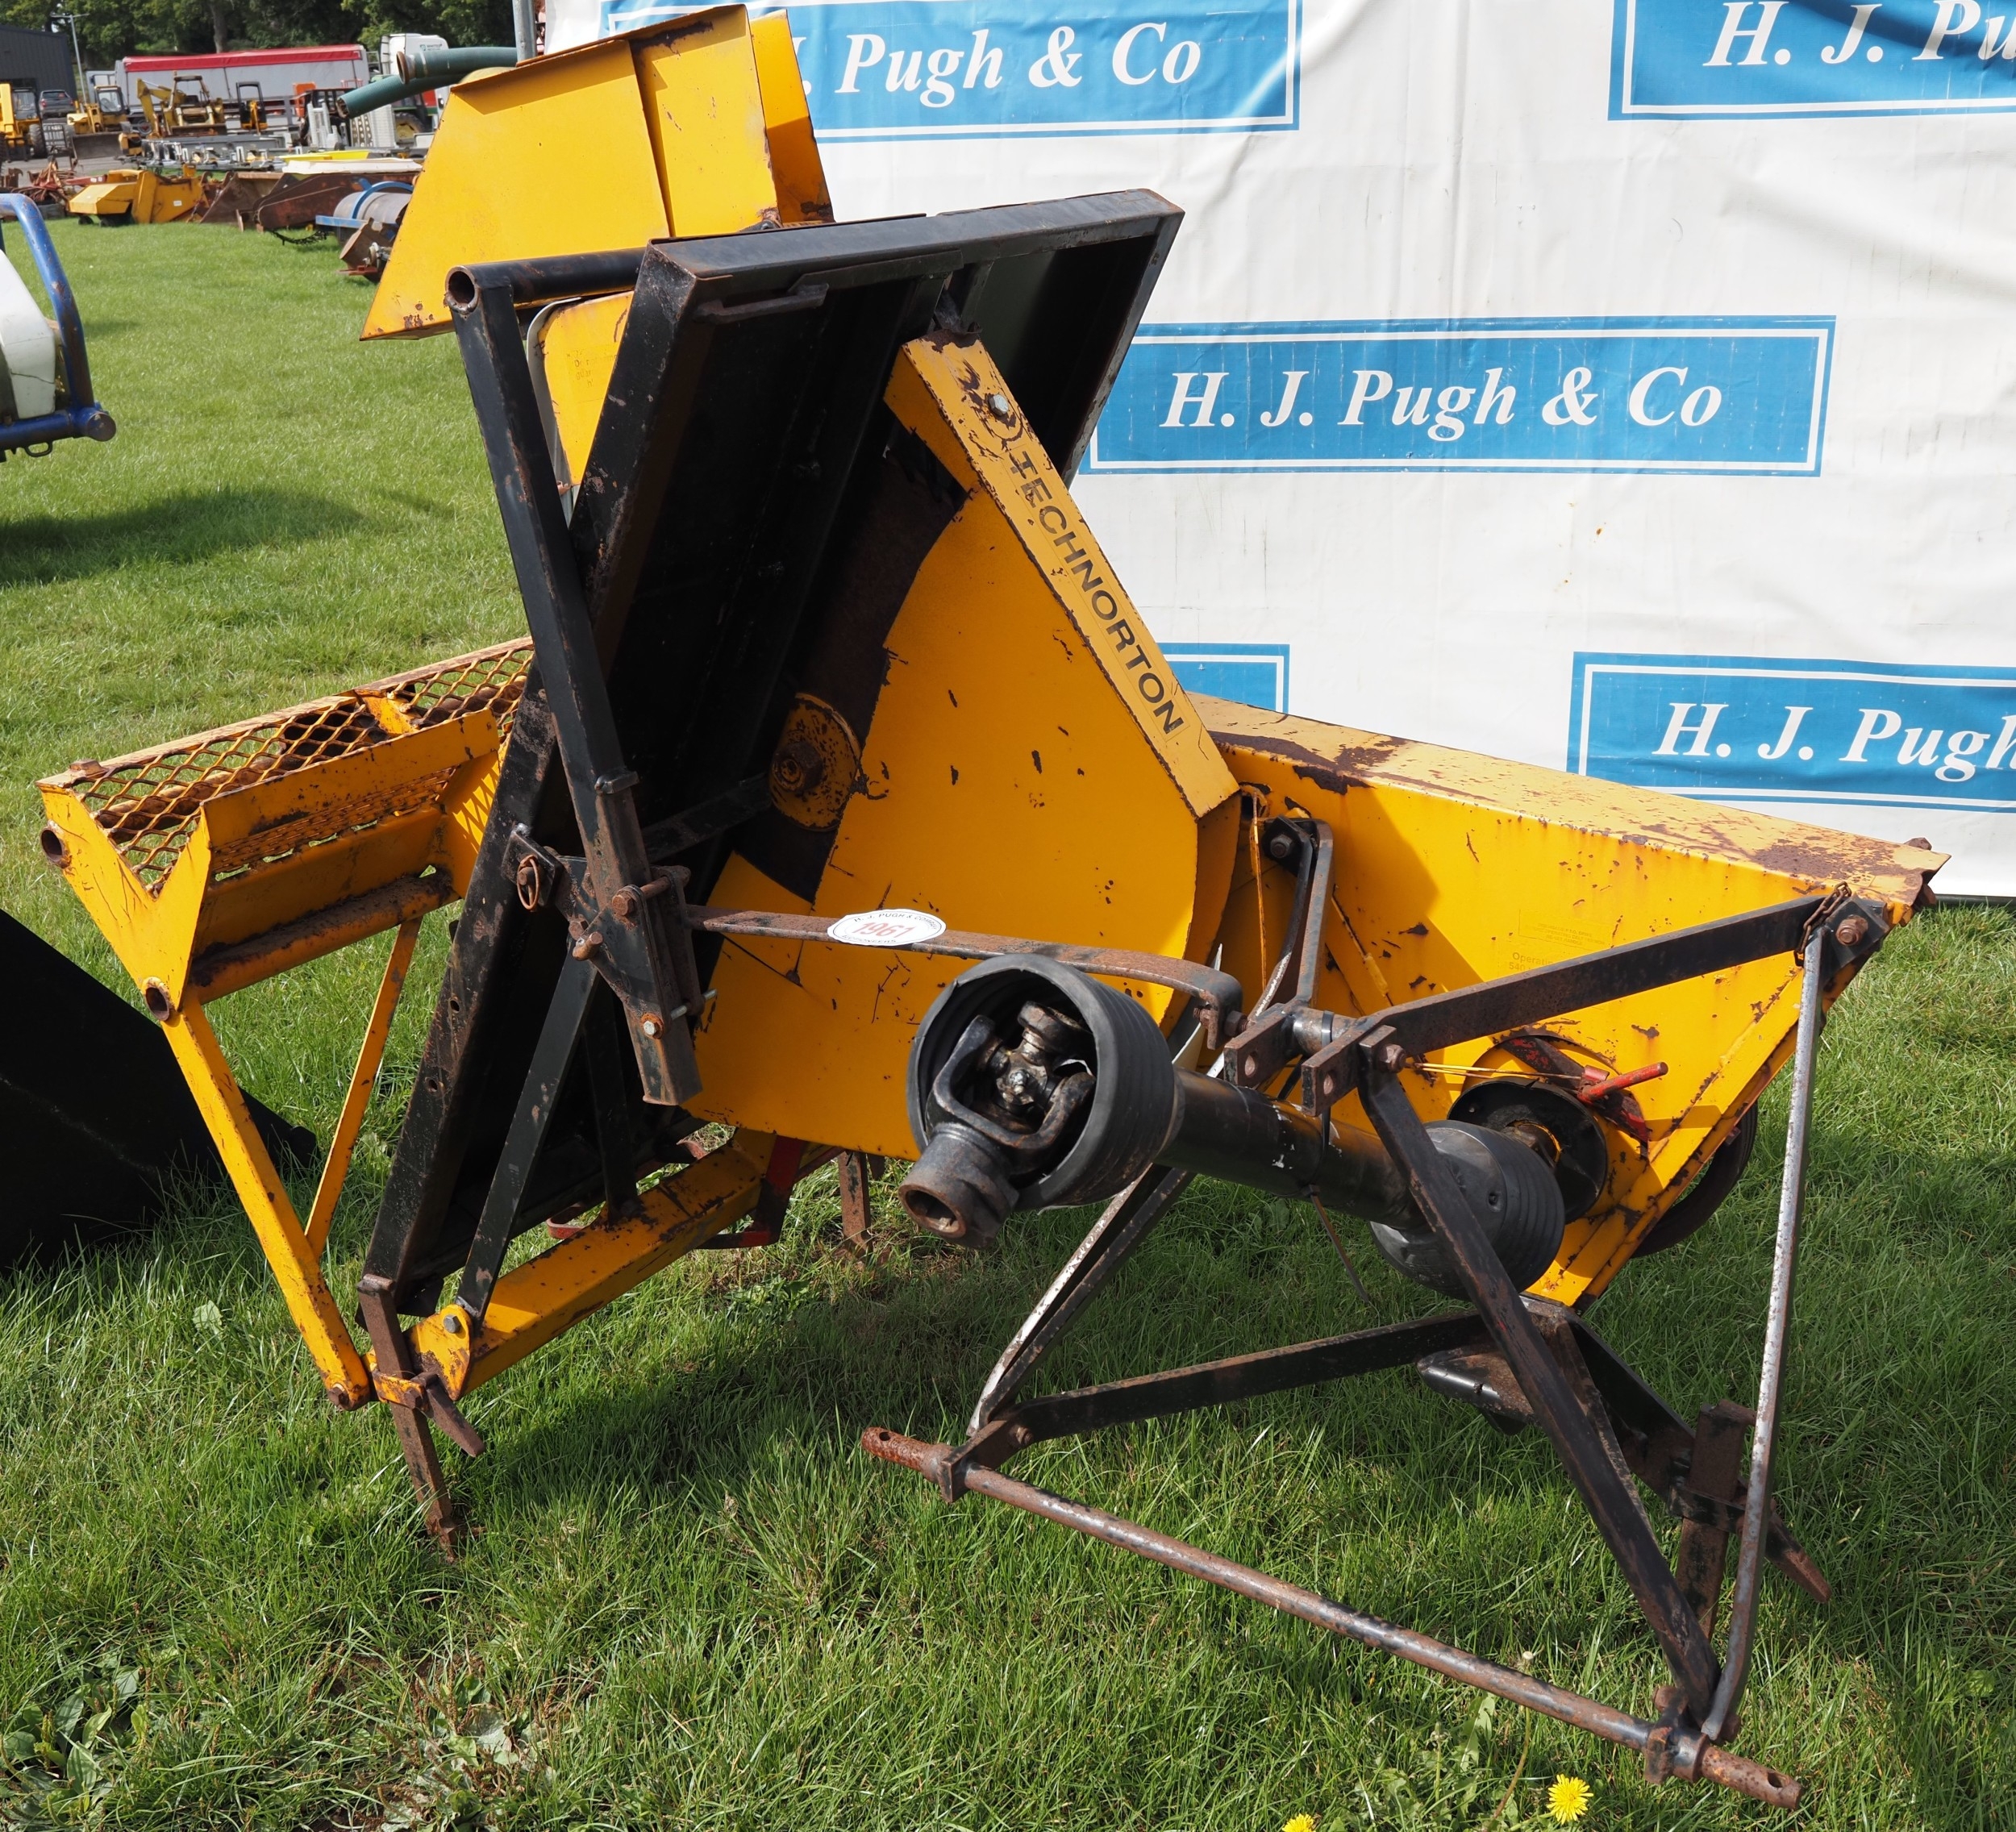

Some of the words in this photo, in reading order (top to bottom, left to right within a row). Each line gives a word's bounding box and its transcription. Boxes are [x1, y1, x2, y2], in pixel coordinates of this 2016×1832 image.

[835, 29, 1004, 108] Pugh
[1028, 27, 1083, 89] &
[1112, 23, 1202, 86] Co
[1702, 1, 1791, 67] H.
[1821, 3, 1884, 65] J.
[1160, 372, 1235, 427] H.
[1260, 370, 1314, 427] J.
[1338, 367, 1517, 442] Pugh
[1541, 366, 1598, 427] &
[1627, 366, 1722, 427] Co
[1010, 450, 1185, 735] TECHNORTON
[1652, 702, 1731, 758] H.
[1757, 706, 1814, 760] J.
[851, 922, 917, 939] 1961
